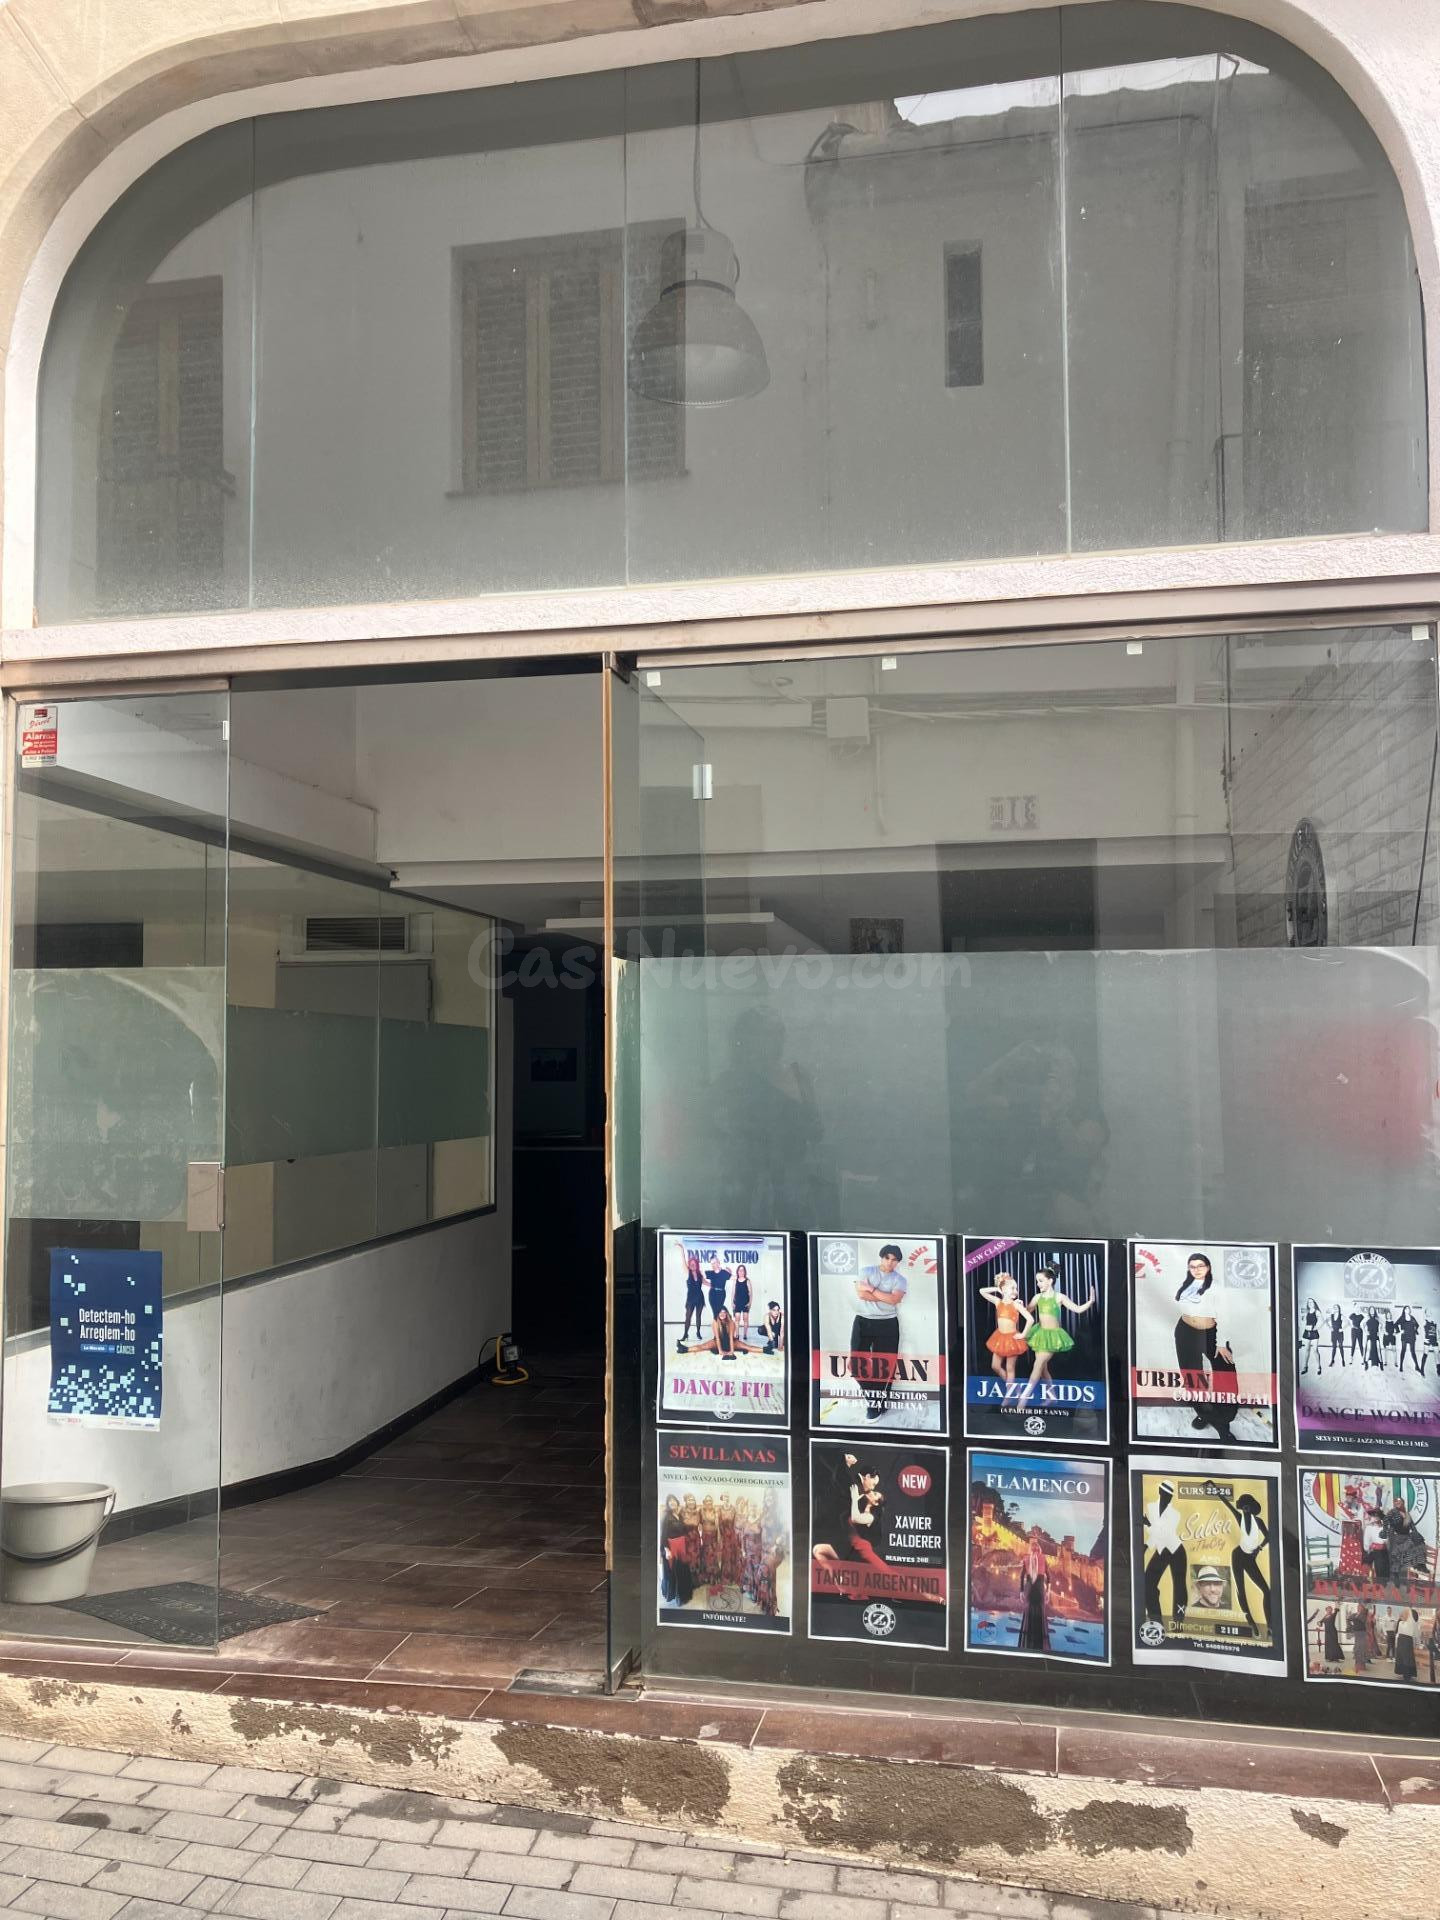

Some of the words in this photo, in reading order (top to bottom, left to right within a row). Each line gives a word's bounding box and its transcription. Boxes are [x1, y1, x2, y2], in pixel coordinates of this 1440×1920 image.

[724, 1250, 758, 1264] STUDIO
[967, 1252, 984, 1265] NEW
[79, 1308, 136, 1325] Detectem-ho
[80, 1325, 136, 1342] Arreglem-ho
[829, 1356, 929, 1382] URBAN
[1136, 1370, 1211, 1389] URBAN
[673, 1379, 736, 1397] DANCE
[742, 1382, 773, 1398] FIT
[829, 1389, 887, 1399] DIFERENTES
[889, 1391, 928, 1401] ESTILOS
[977, 1381, 1035, 1400] JAZZ
[1040, 1383, 1095, 1403] KIDS
[884, 1401, 923, 1411] URBANA
[1172, 1389, 1271, 1407] COMMERCIAL
[1301, 1404, 1365, 1421] DANCE
[669, 1444, 776, 1463] SEVILLANAS
[902, 1474, 928, 1489] NEW
[986, 1473, 1090, 1495] FLAMENCO
[1179, 1487, 1204, 1495] CURS
[895, 1515, 932, 1530] XAVIER
[1180, 1509, 1232, 1541] Salsa
[889, 1533, 942, 1549] CALDERER
[885, 1555, 915, 1563] MARTES
[816, 1568, 860, 1588] TANGO
[864, 1571, 940, 1595] ARGENTINO
